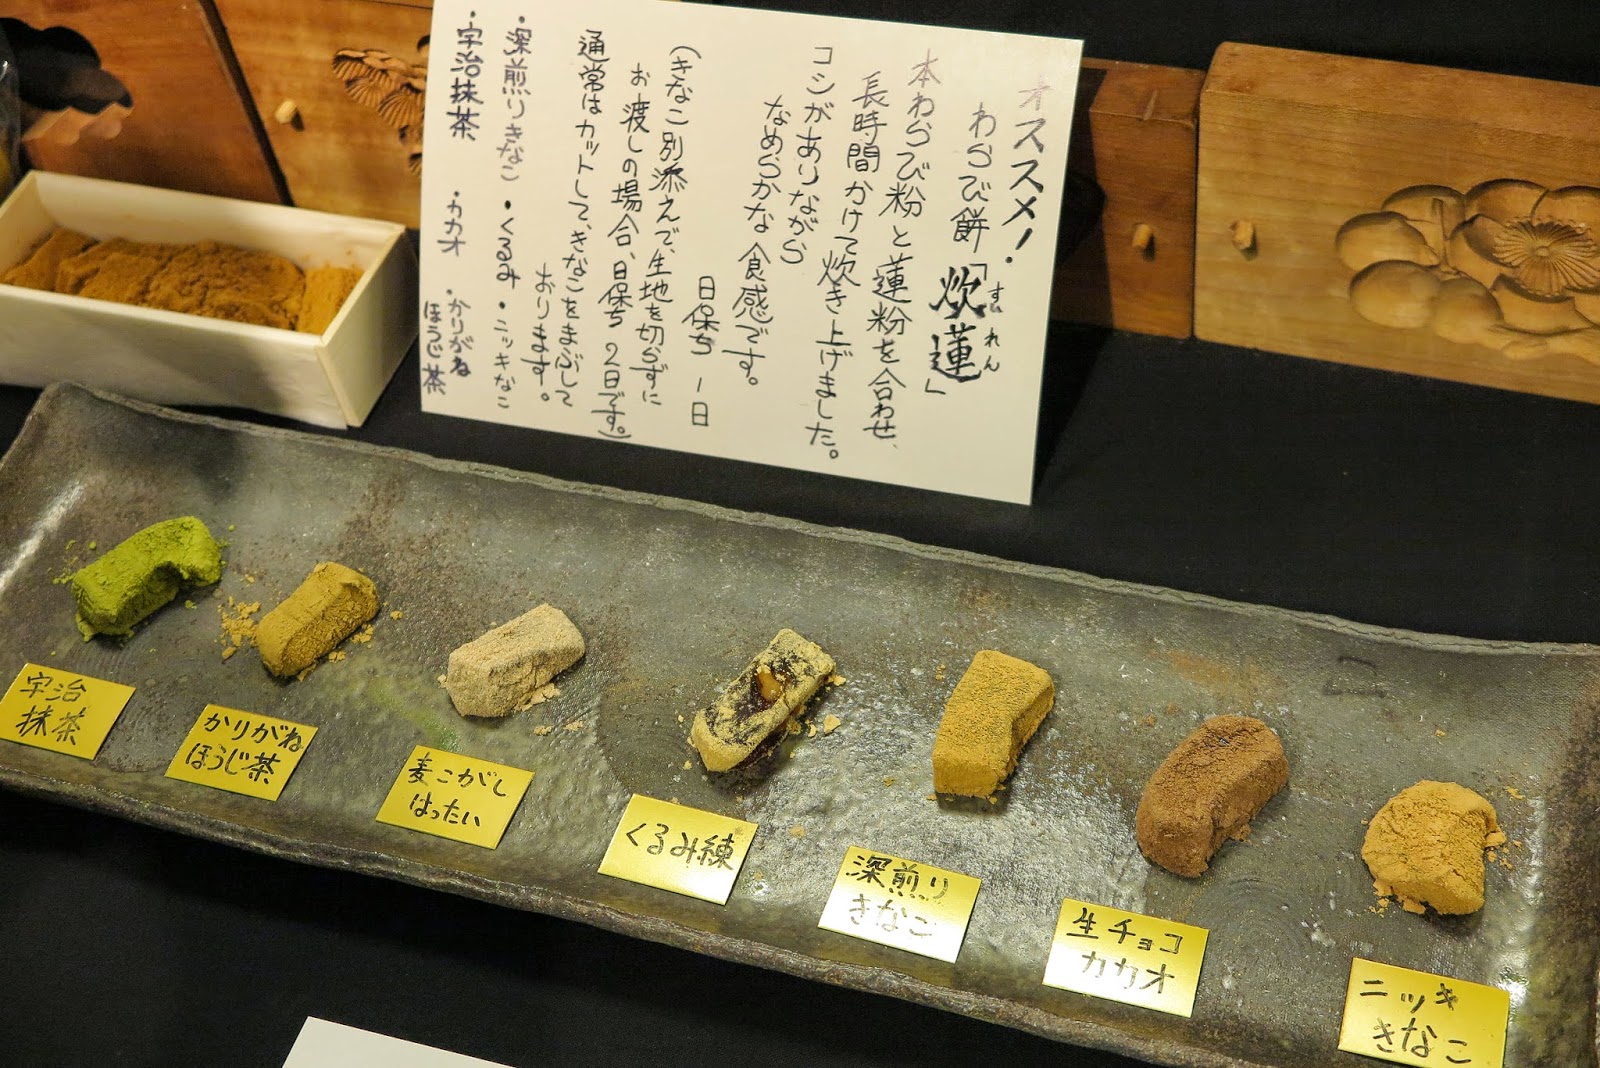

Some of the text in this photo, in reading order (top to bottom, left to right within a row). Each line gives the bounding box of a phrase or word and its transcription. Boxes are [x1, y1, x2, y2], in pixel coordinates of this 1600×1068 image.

[15, 705, 91, 747] 抹茶
[203, 712, 304, 753] かりがね
[185, 741, 281, 786] ほうじ茶
[409, 791, 482, 829] はったい
[625, 822, 735, 871] くるみ練
[845, 854, 950, 902] 深煎り
[848, 893, 938, 938] きなこ
[1066, 906, 1184, 956] 生チョコ
[1080, 950, 1176, 996] カカオ
[1359, 979, 1460, 1015] ニッキ
[1372, 1016, 1474, 1065] きなこ
